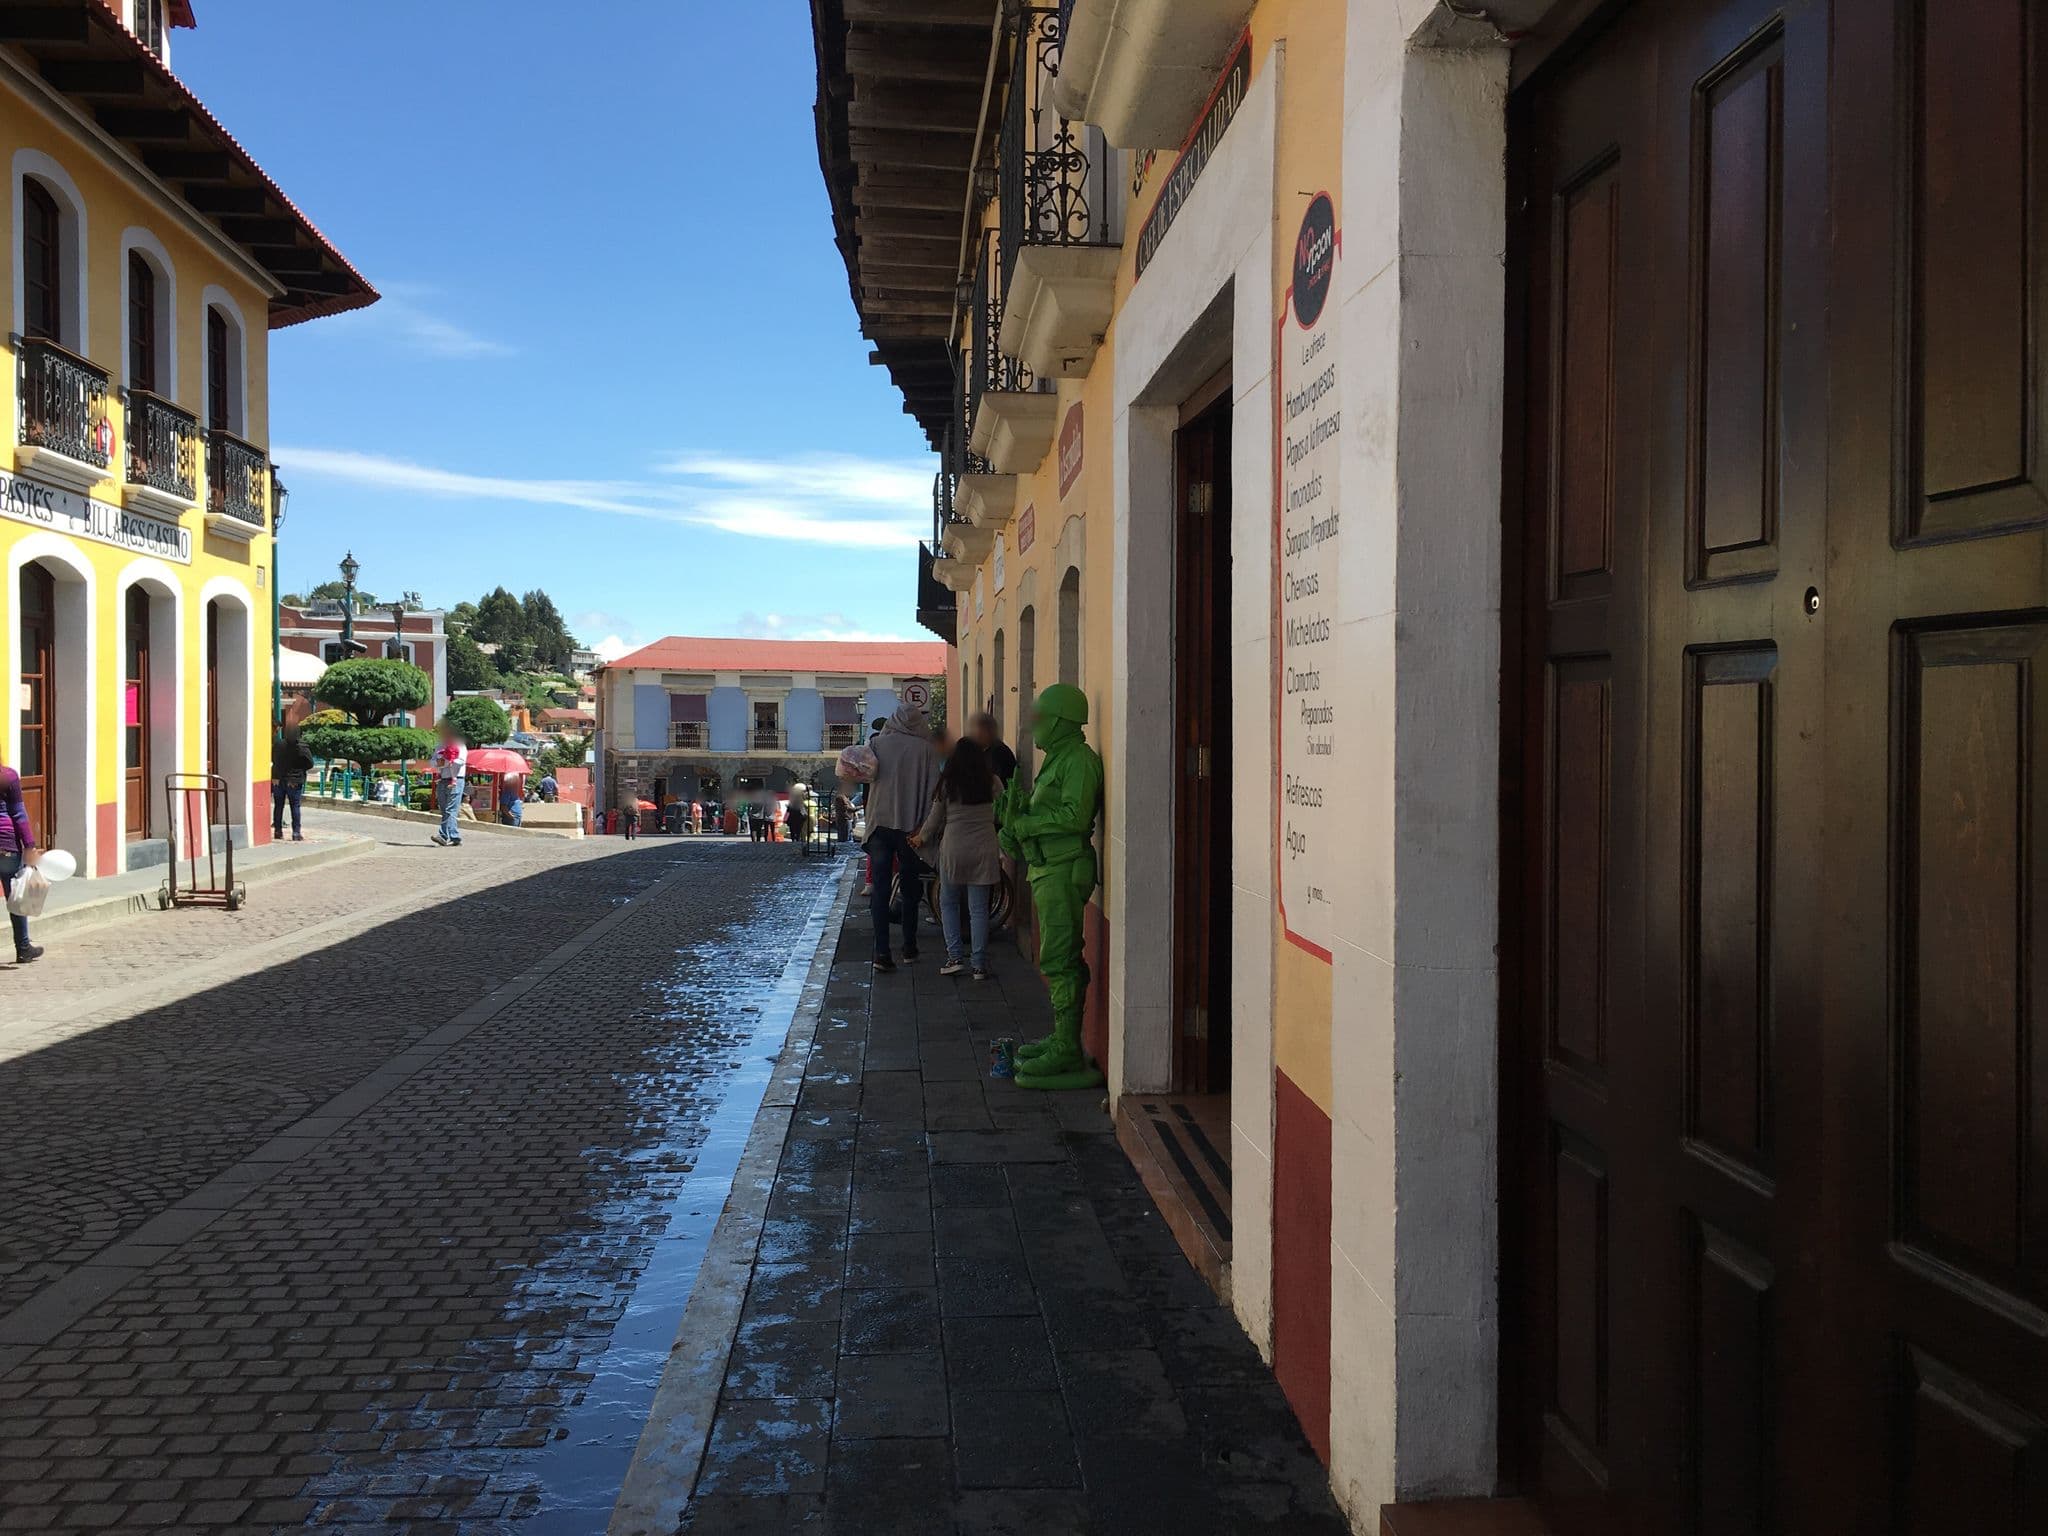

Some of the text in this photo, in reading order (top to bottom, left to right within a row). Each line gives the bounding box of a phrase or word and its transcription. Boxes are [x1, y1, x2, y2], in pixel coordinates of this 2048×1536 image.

[1168, 66, 1241, 223] ESPECIALIDAD
[1286, 363, 1335, 422] Hamburguesas
[1286, 436, 1305, 471] Papas
[1286, 470, 1322, 512] Limonadas
[0, 476, 188, 559] PASTES BILLARES CASINO
[1286, 612, 1330, 648] Micheladas
[1286, 661, 1321, 694] Clamatos
[1301, 698, 1334, 731] Preparados
[1286, 774, 1323, 807] Refrescos
[1285, 820, 1306, 860] Agua
